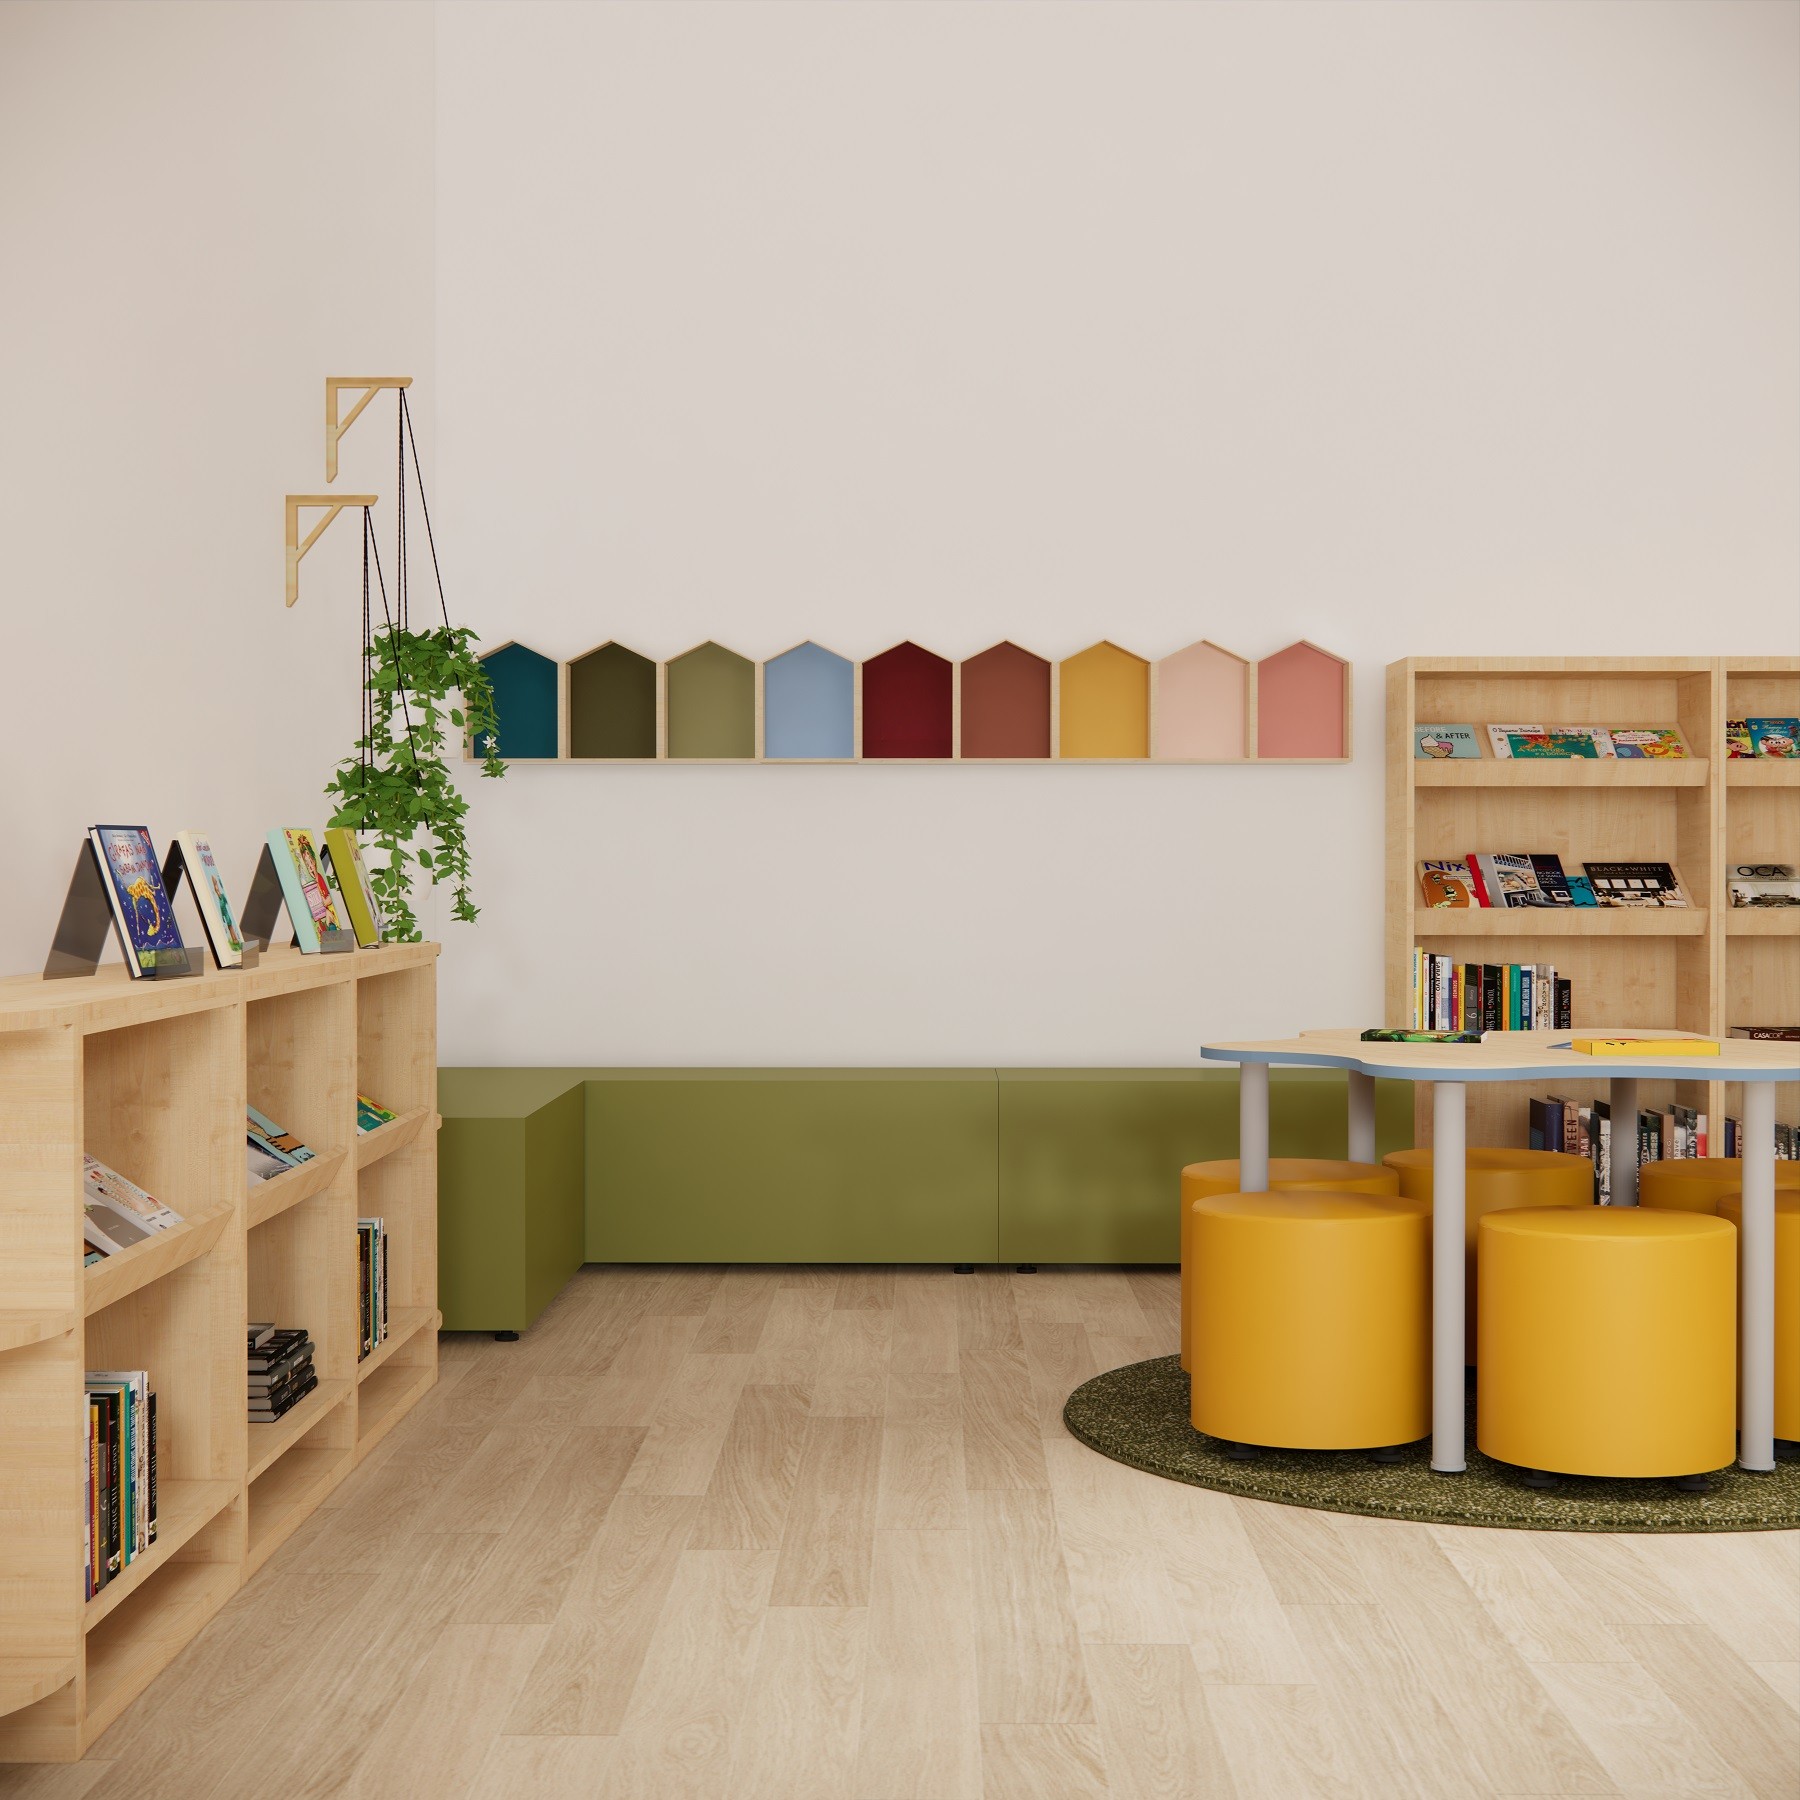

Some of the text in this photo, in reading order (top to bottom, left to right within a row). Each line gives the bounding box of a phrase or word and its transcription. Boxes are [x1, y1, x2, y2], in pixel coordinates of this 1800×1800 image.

[1435, 732, 1471, 740] & AFTER
[1736, 866, 1787, 877] OCA
[1487, 988, 1495, 1006] YOUNG
[1562, 989, 1570, 1006] YOUNG
[1486, 1010, 1496, 1020] THE
[1561, 1010, 1571, 1020] THE
